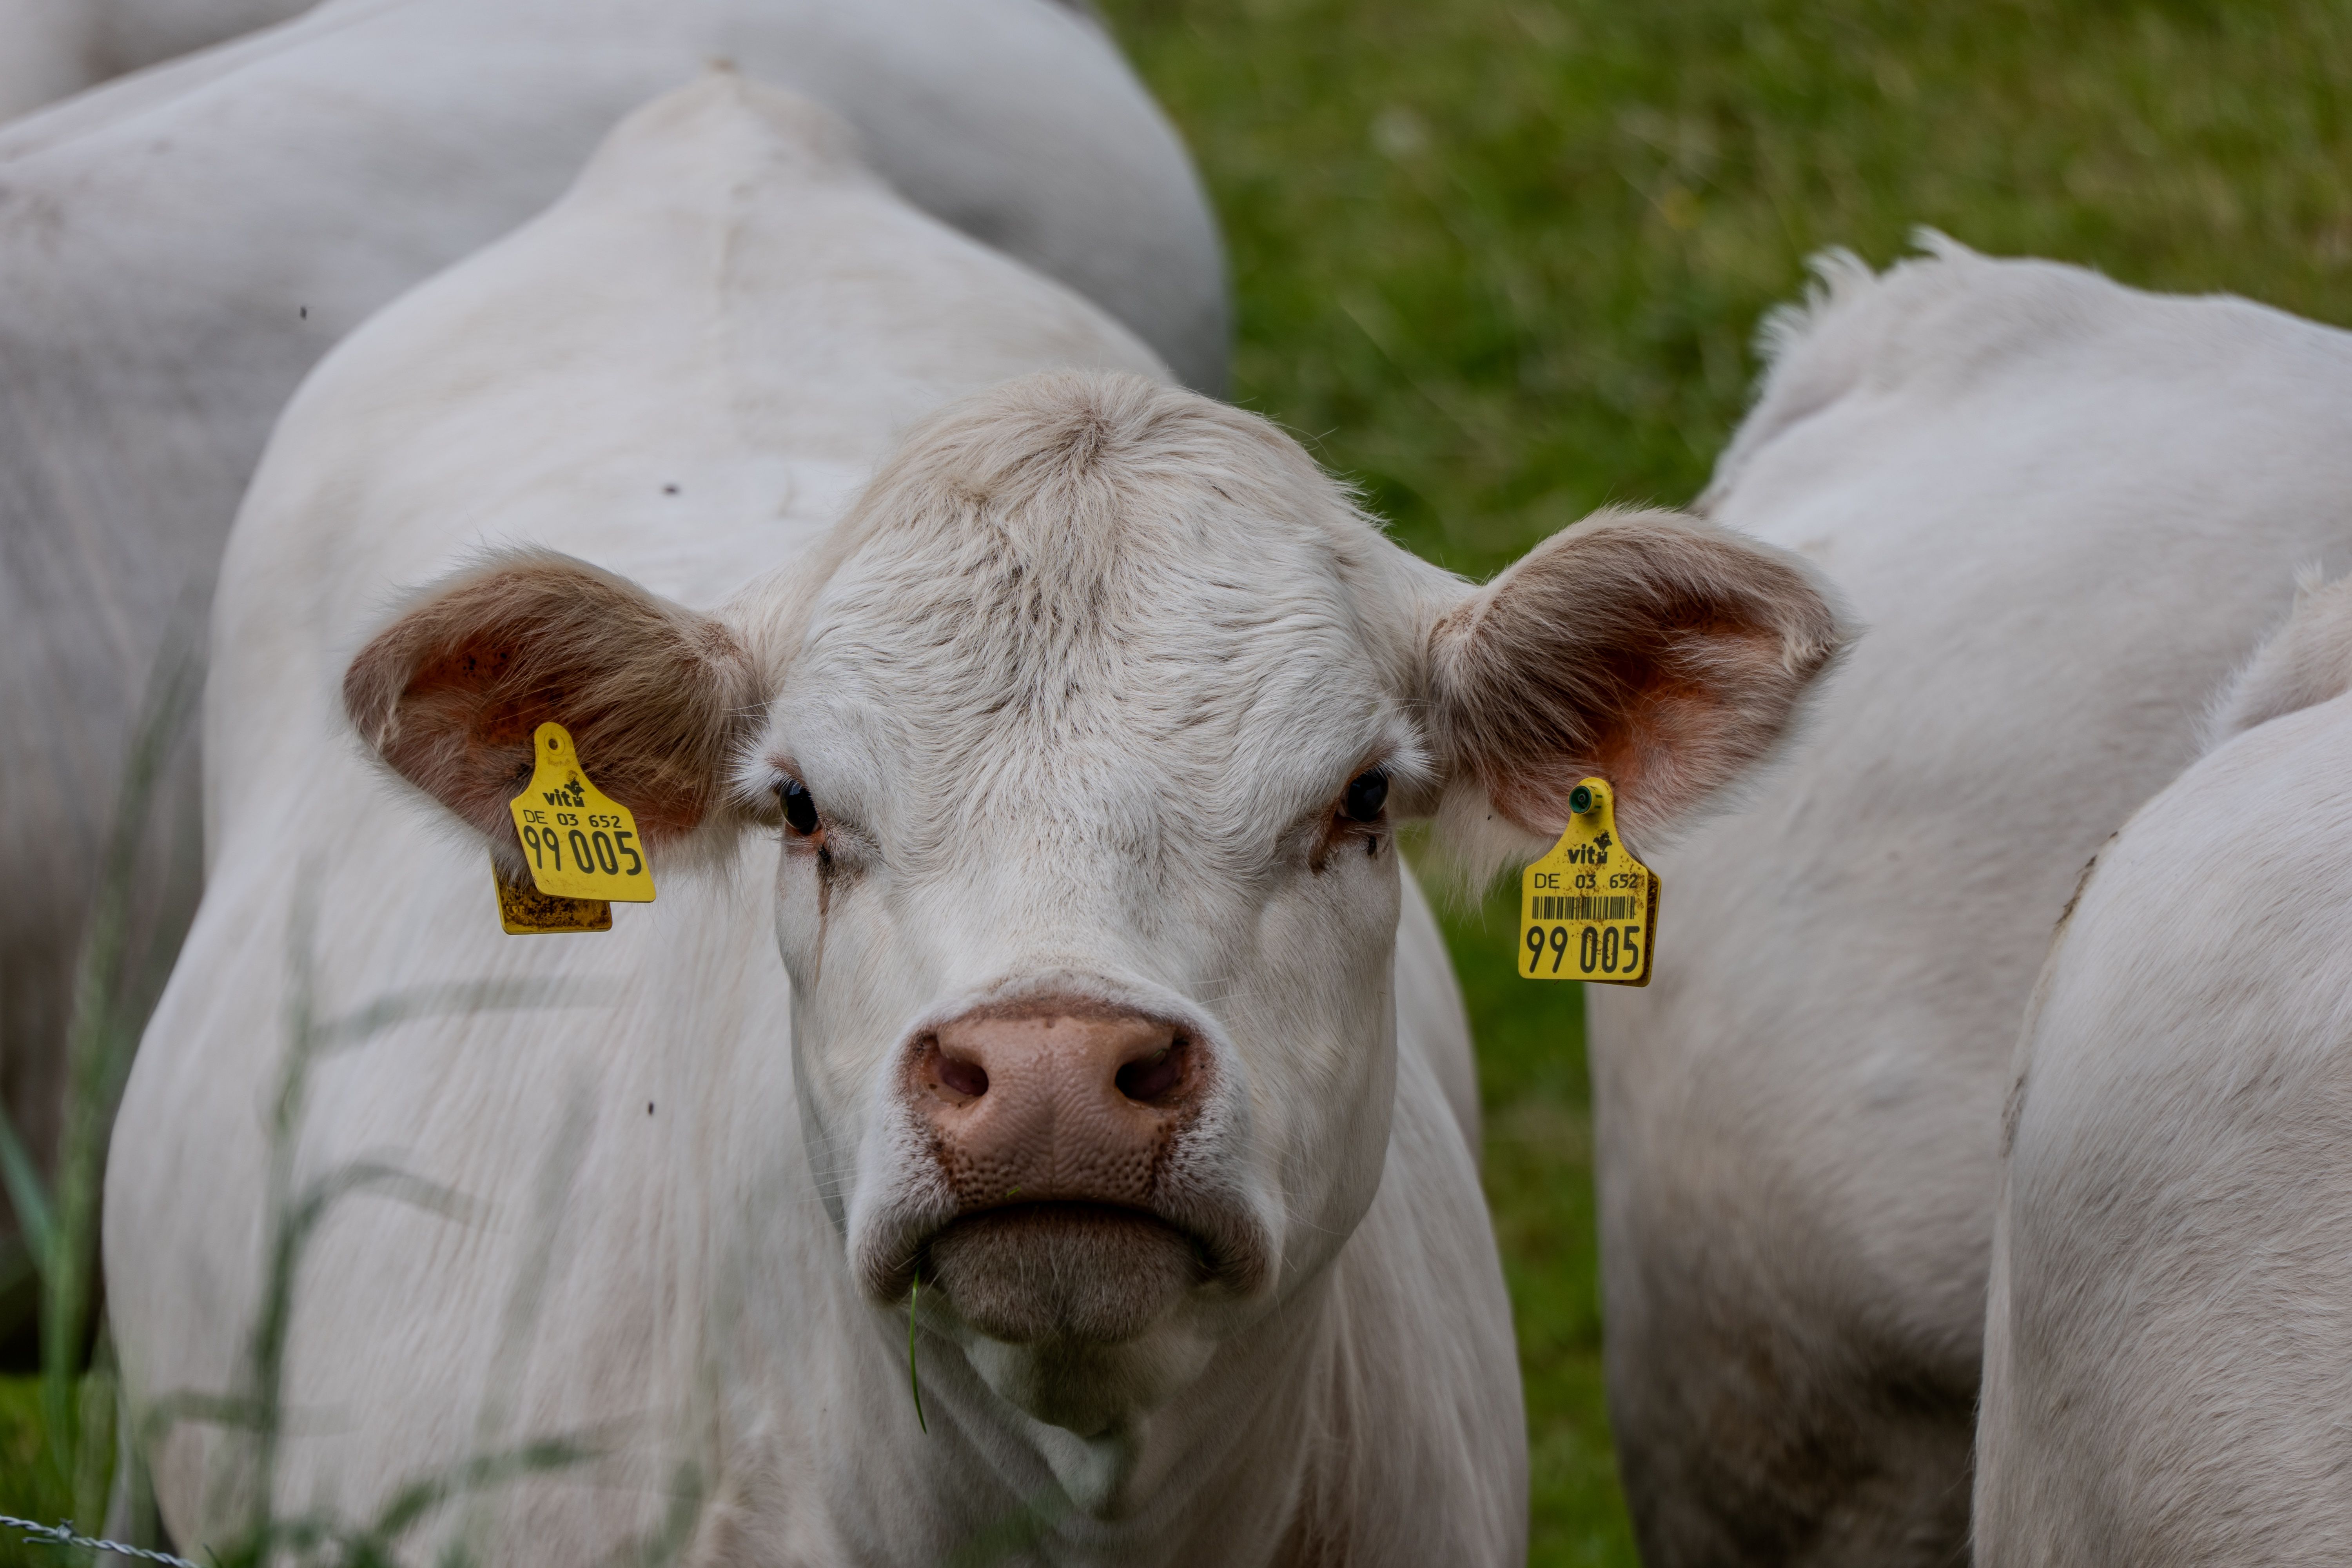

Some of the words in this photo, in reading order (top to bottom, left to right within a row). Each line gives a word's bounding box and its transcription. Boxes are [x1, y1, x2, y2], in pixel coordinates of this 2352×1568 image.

[523, 809, 548, 824] DE
[557, 813, 579, 826] 03
[588, 815, 622, 828] 652
[523, 825, 561, 871] 99
[568, 829, 642, 876] 005
[1534, 873, 1560, 889] DE
[1575, 874, 1596, 889] 03
[1609, 873, 1640, 889] 652
[1526, 926, 1568, 973] 99
[1580, 926, 1641, 973] 005
